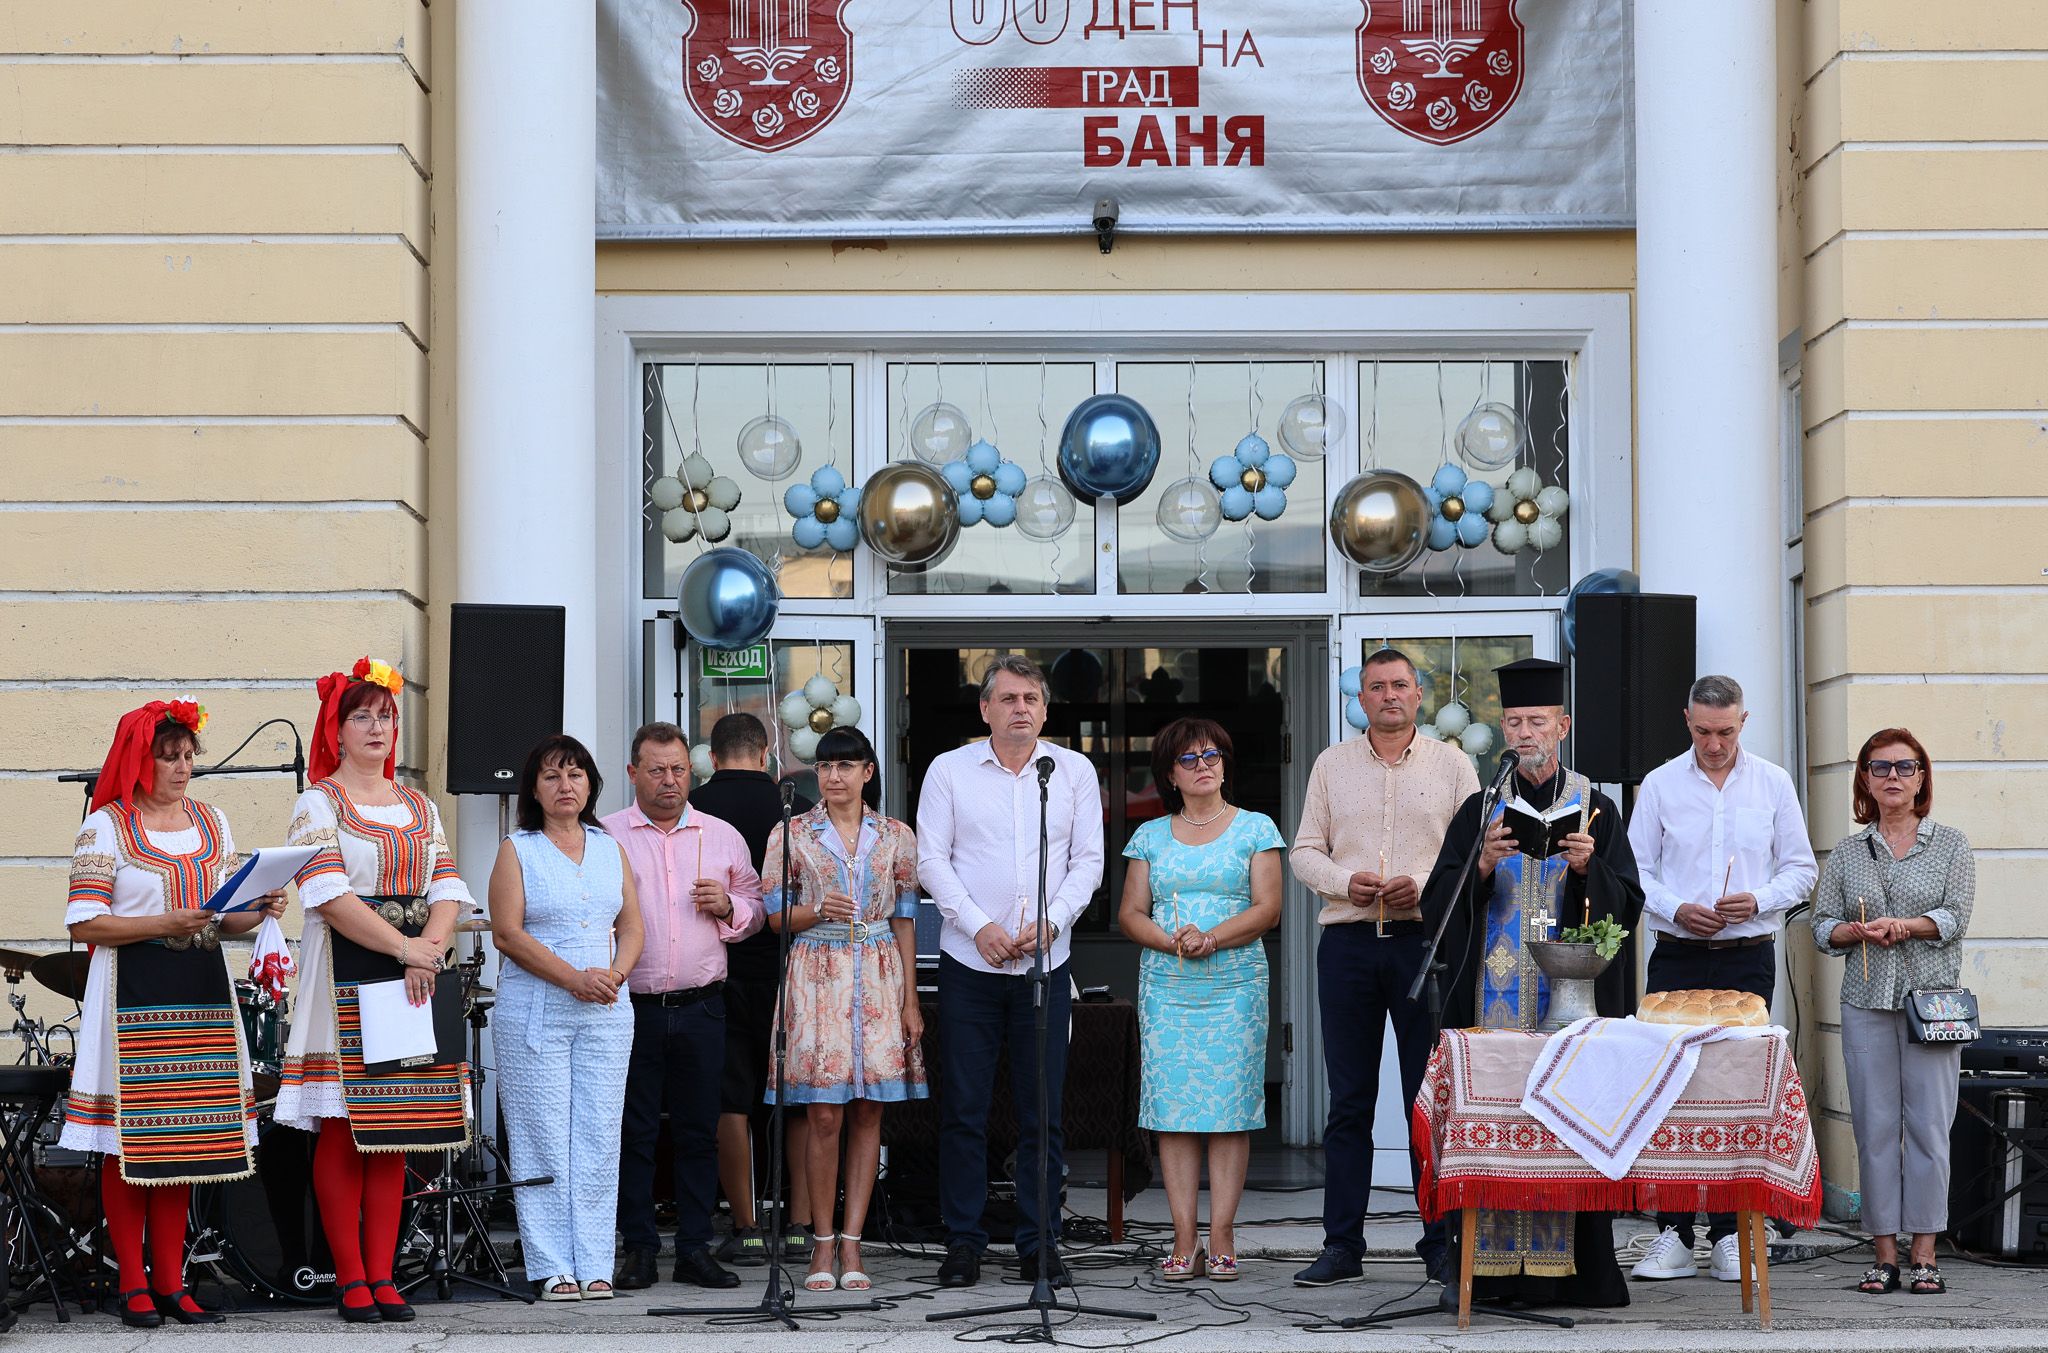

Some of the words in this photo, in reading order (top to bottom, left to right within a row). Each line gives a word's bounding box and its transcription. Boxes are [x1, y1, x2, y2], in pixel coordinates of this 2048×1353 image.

[1083, 0, 1199, 40] ДЕН
[1198, 28, 1264, 67] НА
[1081, 70, 1173, 107] ГРАД
[1083, 115, 1265, 168] БАНЯ
[707, 649, 762, 669] ИЗХОД
[1922, 1023, 1979, 1041] braccialini
[743, 1238, 764, 1248] PUMA
